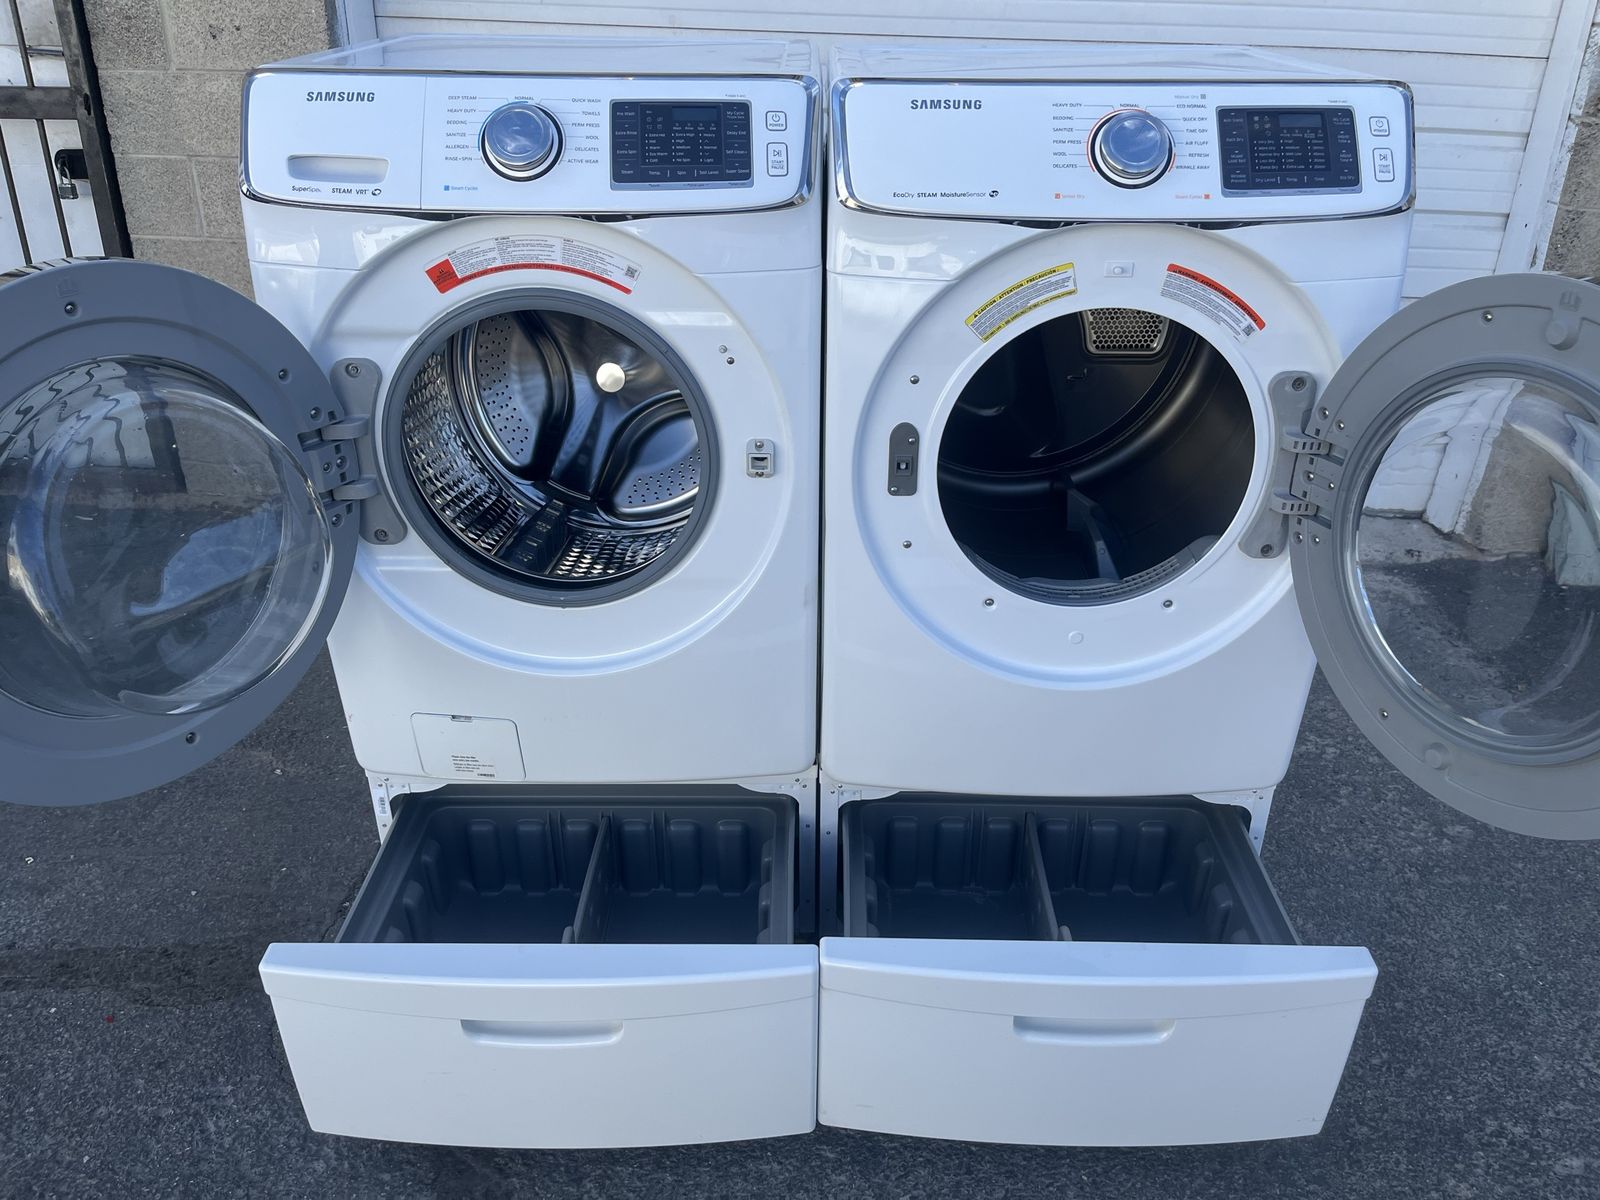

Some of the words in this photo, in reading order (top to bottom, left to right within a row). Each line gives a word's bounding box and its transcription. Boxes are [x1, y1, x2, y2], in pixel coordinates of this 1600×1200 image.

[306, 91, 376, 102] SAMSUNG
[910, 99, 982, 110] SAMSUNG
[978, 299, 997, 315] CAUTION
[998, 283, 1024, 299] ATTENTION
